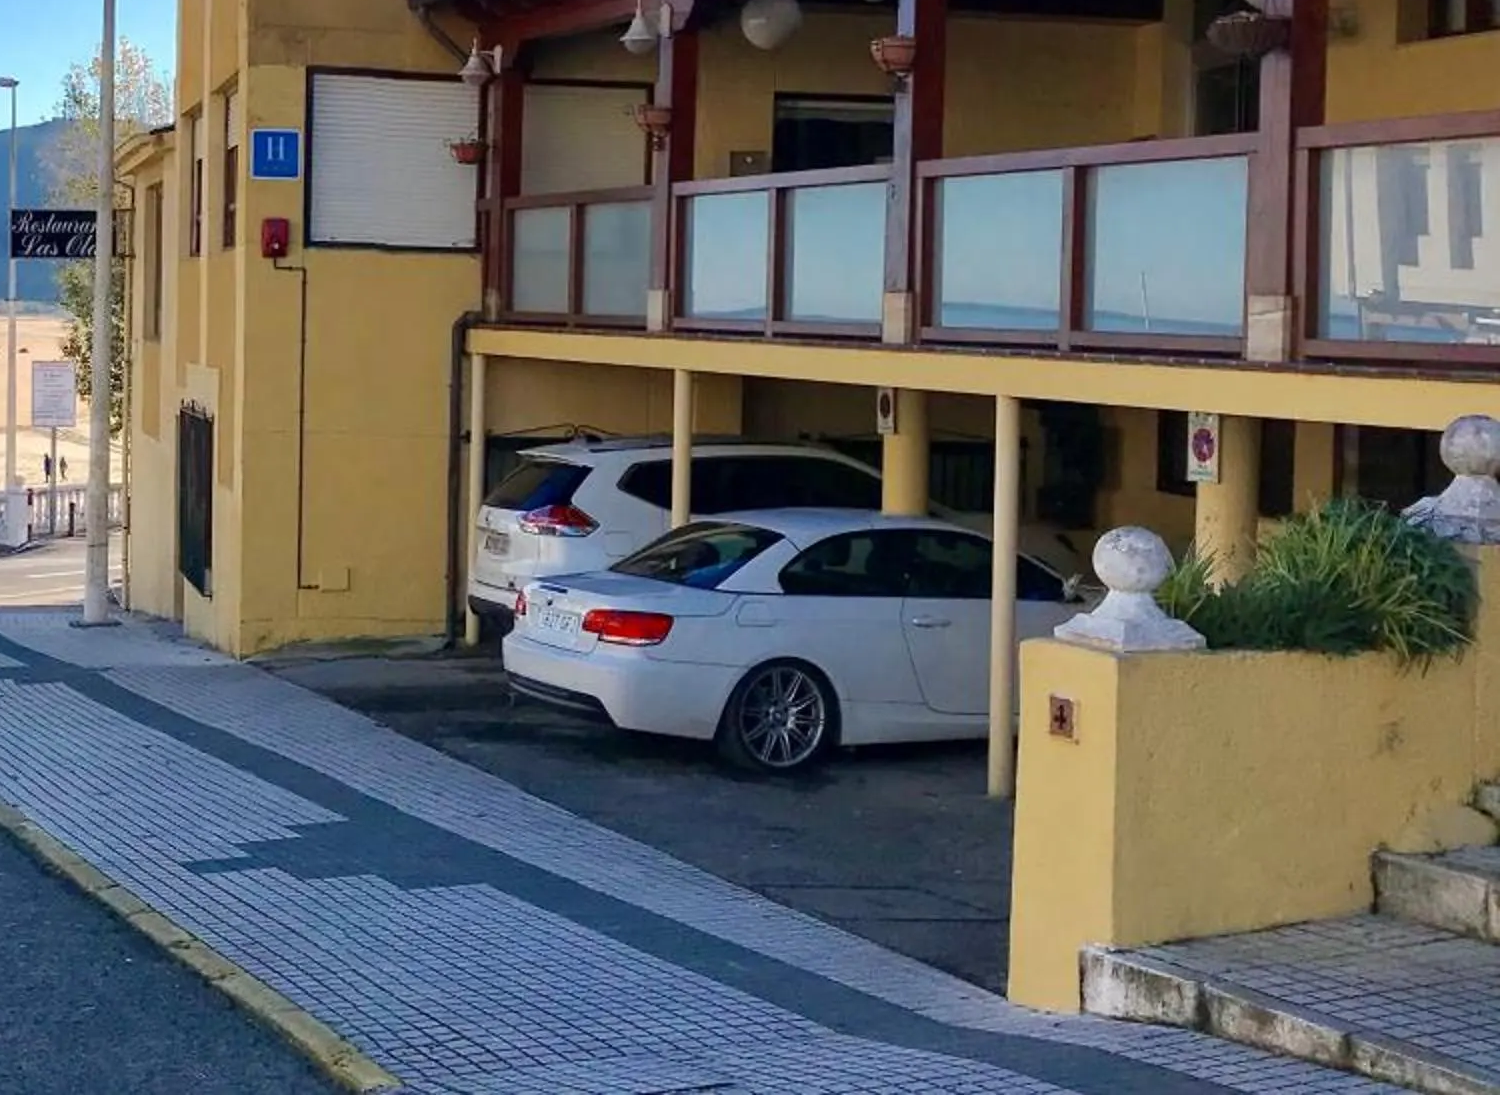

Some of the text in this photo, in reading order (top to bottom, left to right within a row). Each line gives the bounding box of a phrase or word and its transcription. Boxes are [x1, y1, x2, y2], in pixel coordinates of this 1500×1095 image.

[266, 136, 285, 161] H
[20, 234, 98, 257] Las Ola
[1052, 704, 1067, 730] 4
